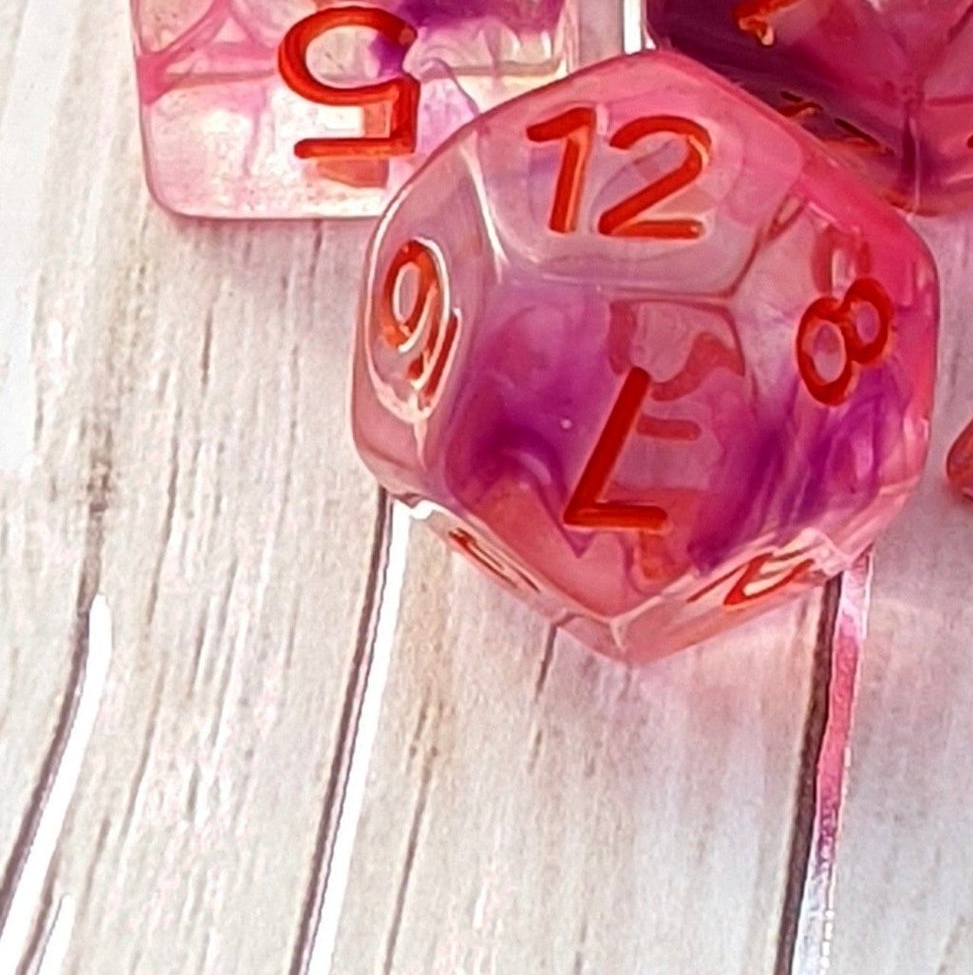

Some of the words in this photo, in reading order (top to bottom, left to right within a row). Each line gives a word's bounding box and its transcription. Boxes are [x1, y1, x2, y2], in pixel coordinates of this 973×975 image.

[278, 6, 420, 158] 5
[526, 106, 712, 240] 12
[796, 276, 895, 406] 8
[563, 366, 668, 530] 7
